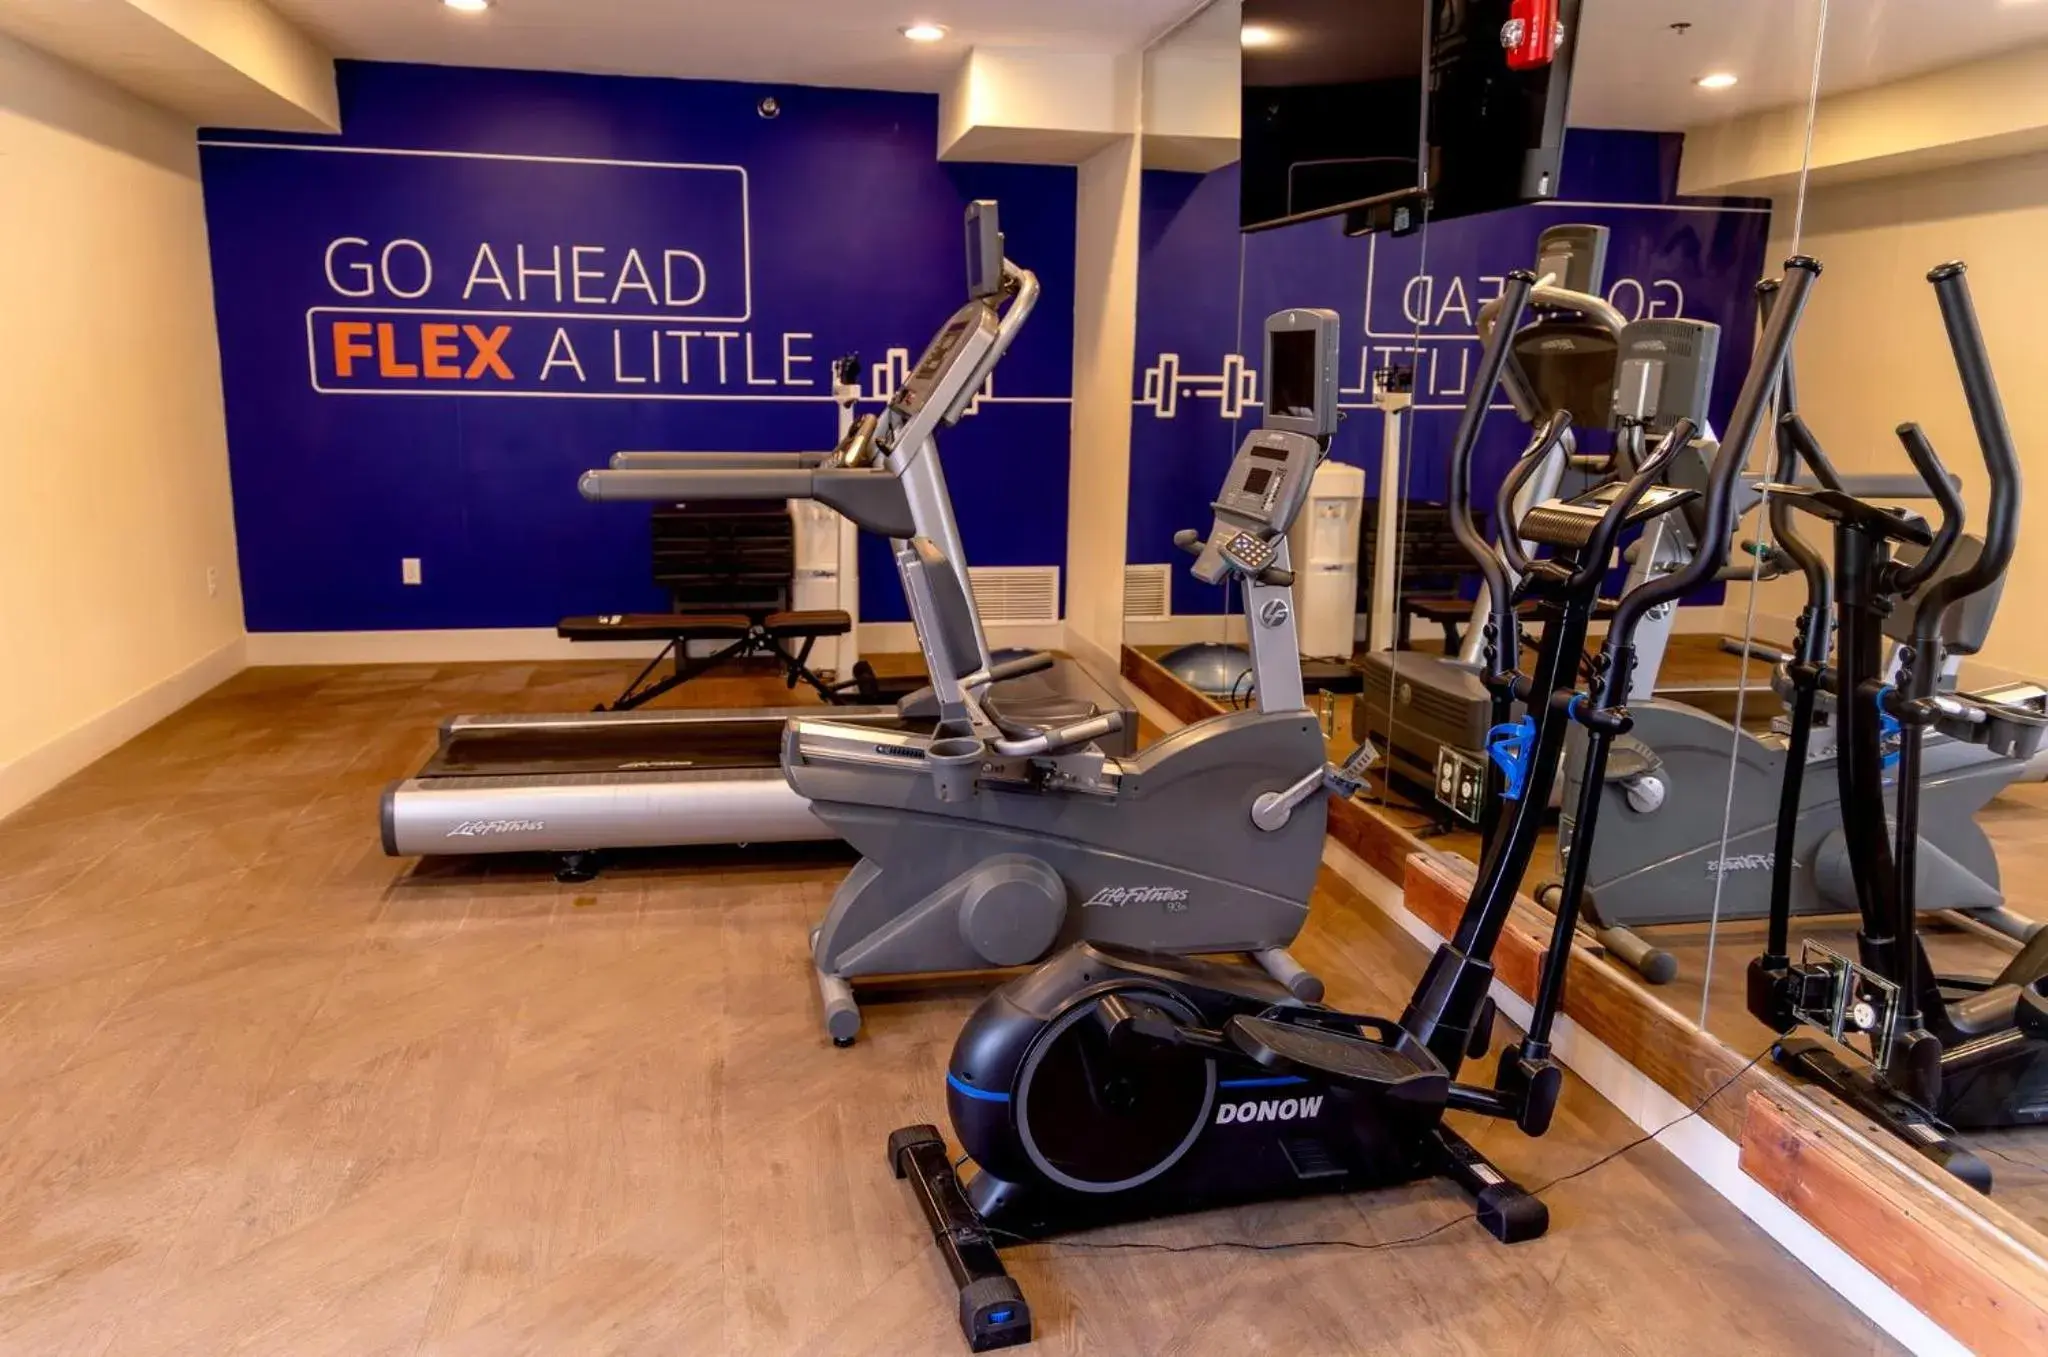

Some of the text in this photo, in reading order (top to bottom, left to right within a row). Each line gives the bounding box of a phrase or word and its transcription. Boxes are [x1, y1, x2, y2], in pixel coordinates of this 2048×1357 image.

[324, 237, 706, 306] GO AHEAD
[332, 321, 814, 385] FLEX A LITTLE
[1215, 1095, 1324, 1124] DONOW
